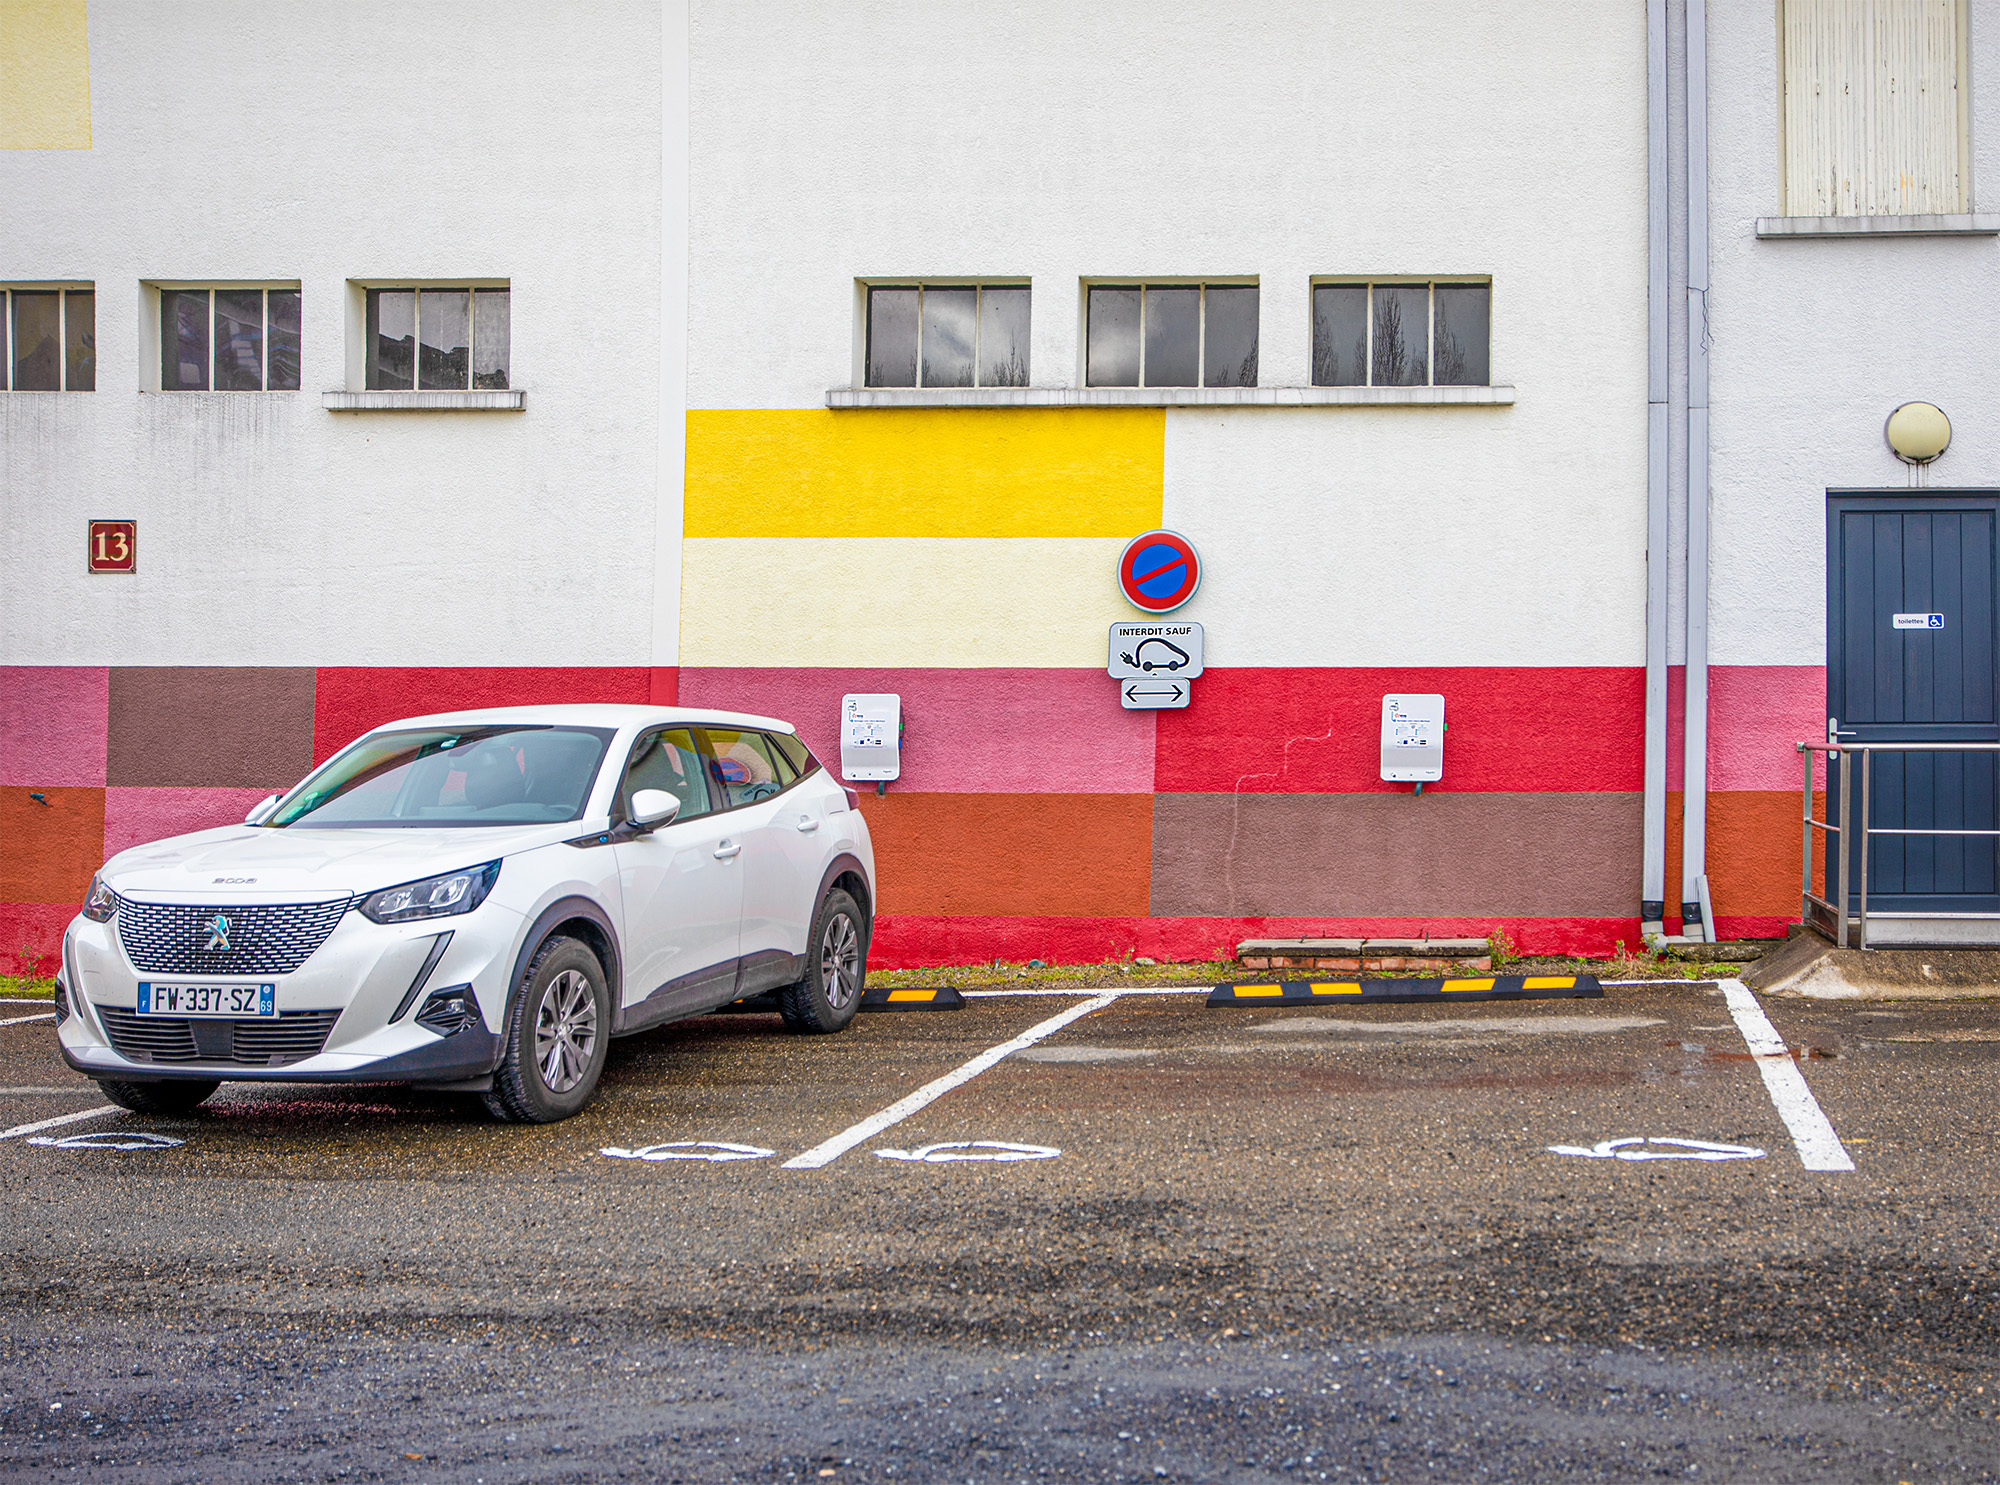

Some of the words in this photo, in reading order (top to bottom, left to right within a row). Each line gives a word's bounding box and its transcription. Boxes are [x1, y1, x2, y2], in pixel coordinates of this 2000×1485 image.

[95, 531, 129, 562] 13
[1119, 627, 1163, 636] INTERDIT
[1166, 627, 1192, 635] SAUF
[260, 1000, 272, 1012] 69
